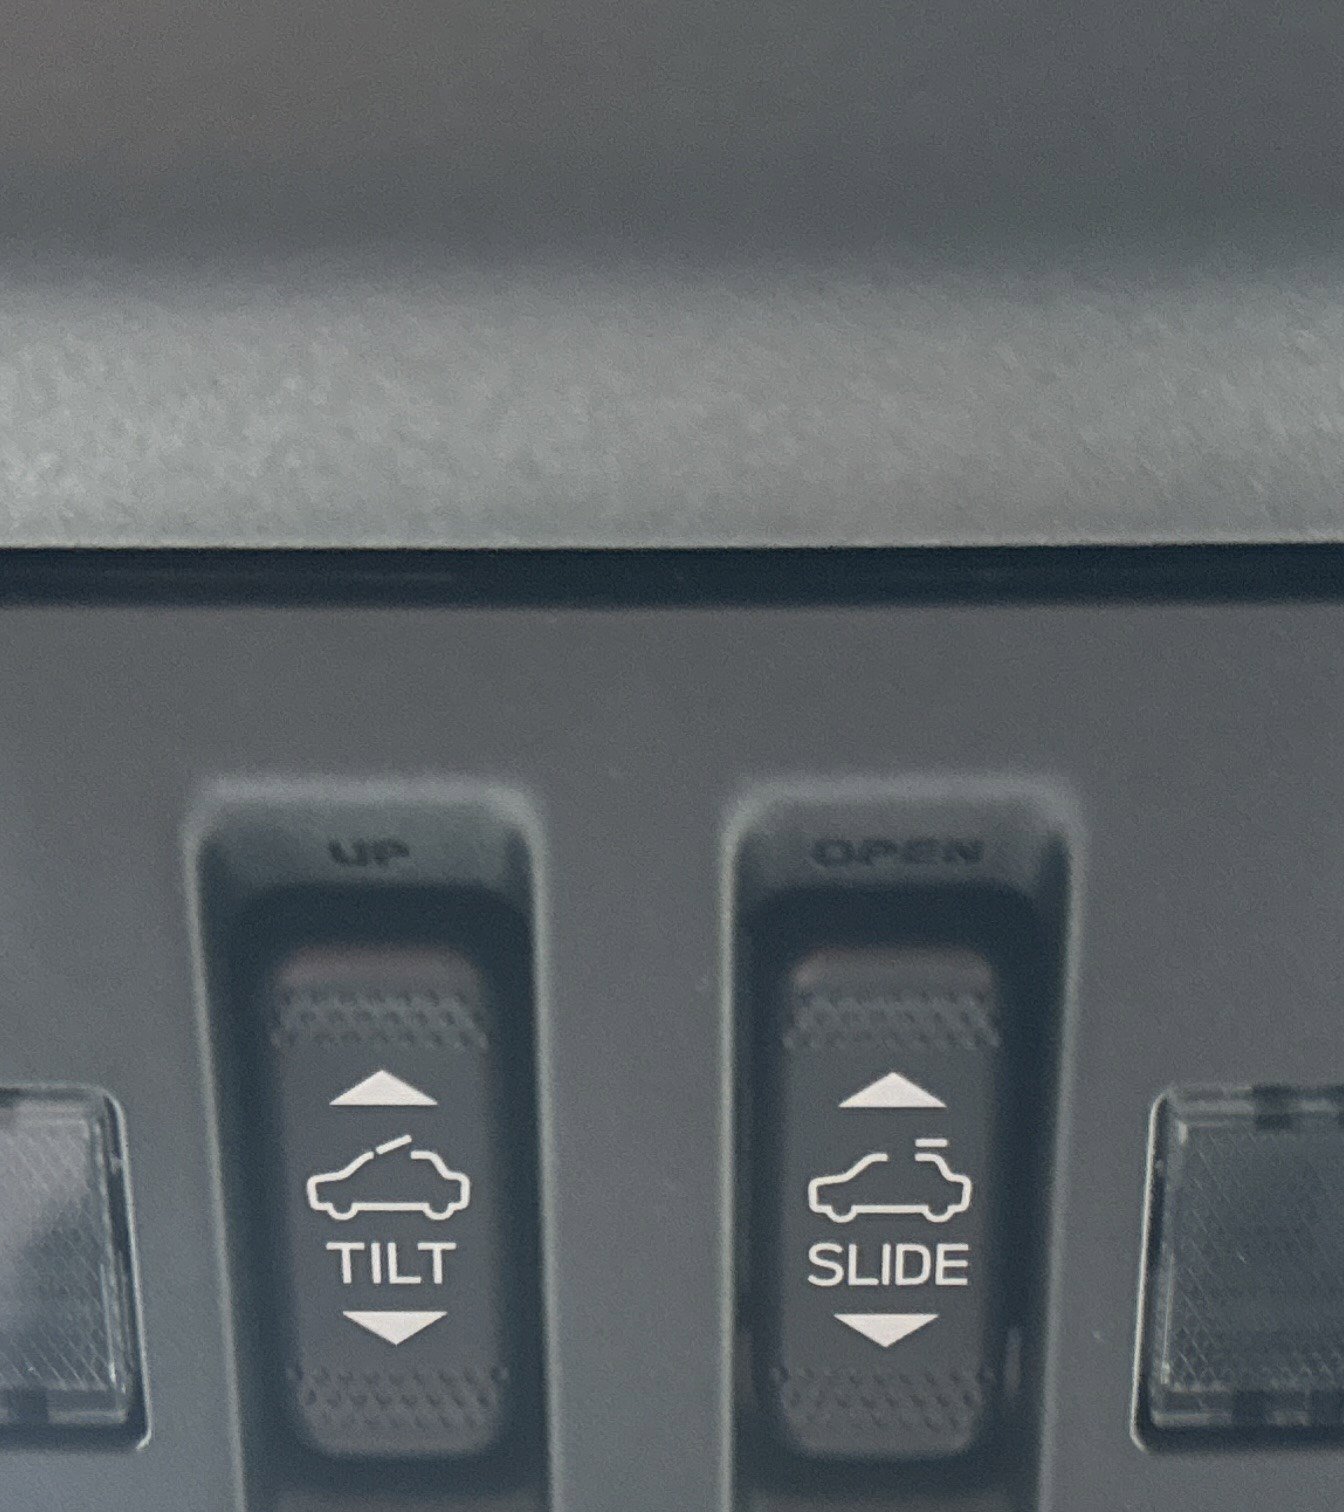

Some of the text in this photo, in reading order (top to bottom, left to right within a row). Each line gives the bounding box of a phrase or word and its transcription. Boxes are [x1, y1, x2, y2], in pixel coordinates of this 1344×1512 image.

[328, 839, 411, 869] UP
[812, 839, 983, 865] OPEN
[326, 1242, 456, 1286] TILT
[807, 1243, 970, 1288] SLIDE
